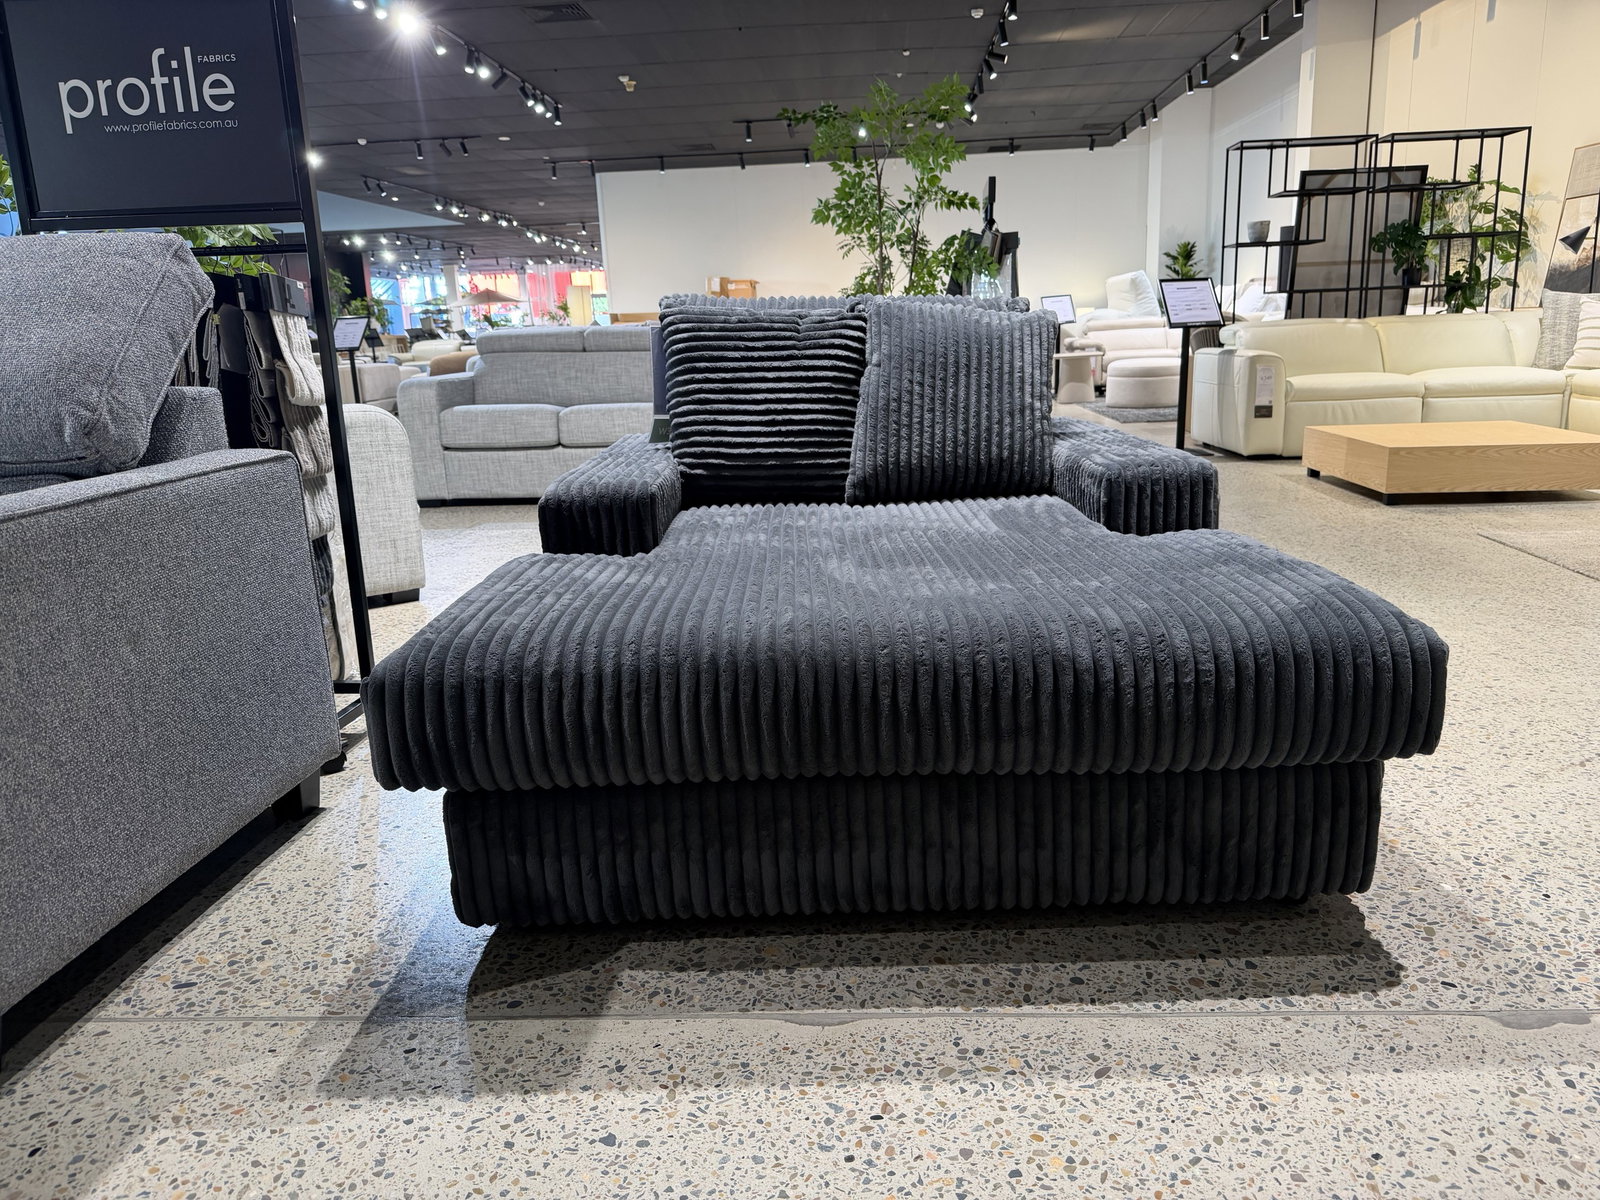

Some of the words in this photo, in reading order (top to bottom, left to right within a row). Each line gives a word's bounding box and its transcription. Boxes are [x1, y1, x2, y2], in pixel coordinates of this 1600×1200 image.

[197, 53, 236, 63] FABRICS
[58, 46, 236, 135] profile
[104, 119, 238, 134] www.profilefabrics.com.au
